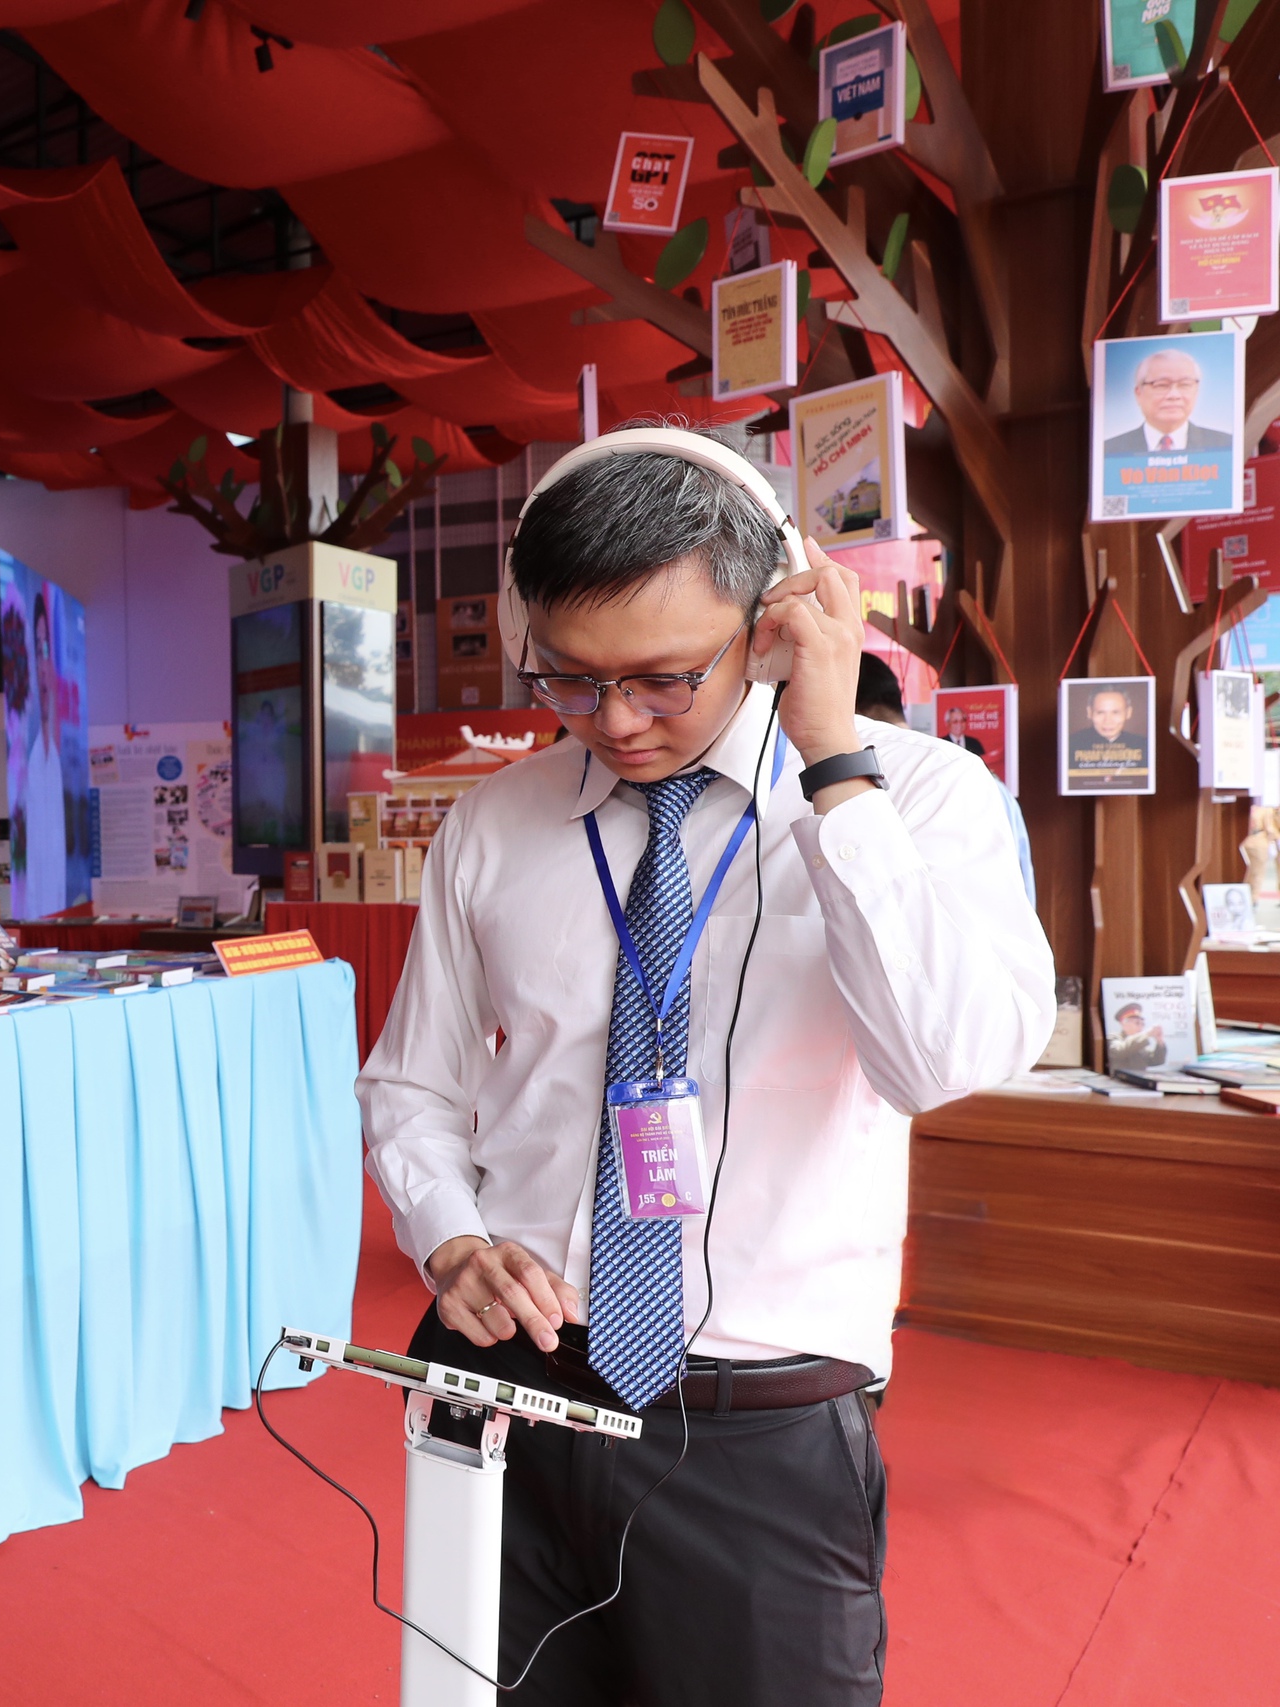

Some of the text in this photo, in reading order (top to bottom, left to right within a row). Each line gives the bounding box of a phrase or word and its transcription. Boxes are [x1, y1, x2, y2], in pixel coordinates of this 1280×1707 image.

[813, 424, 872, 477] HỒ CHÍ MINH
[248, 564, 284, 596] VGP
[338, 562, 375, 592] VGP
[641, 1144, 678, 1163] TRIỂN
[649, 1167, 676, 1182] LÃM
[638, 1191, 692, 1204] 155 C
